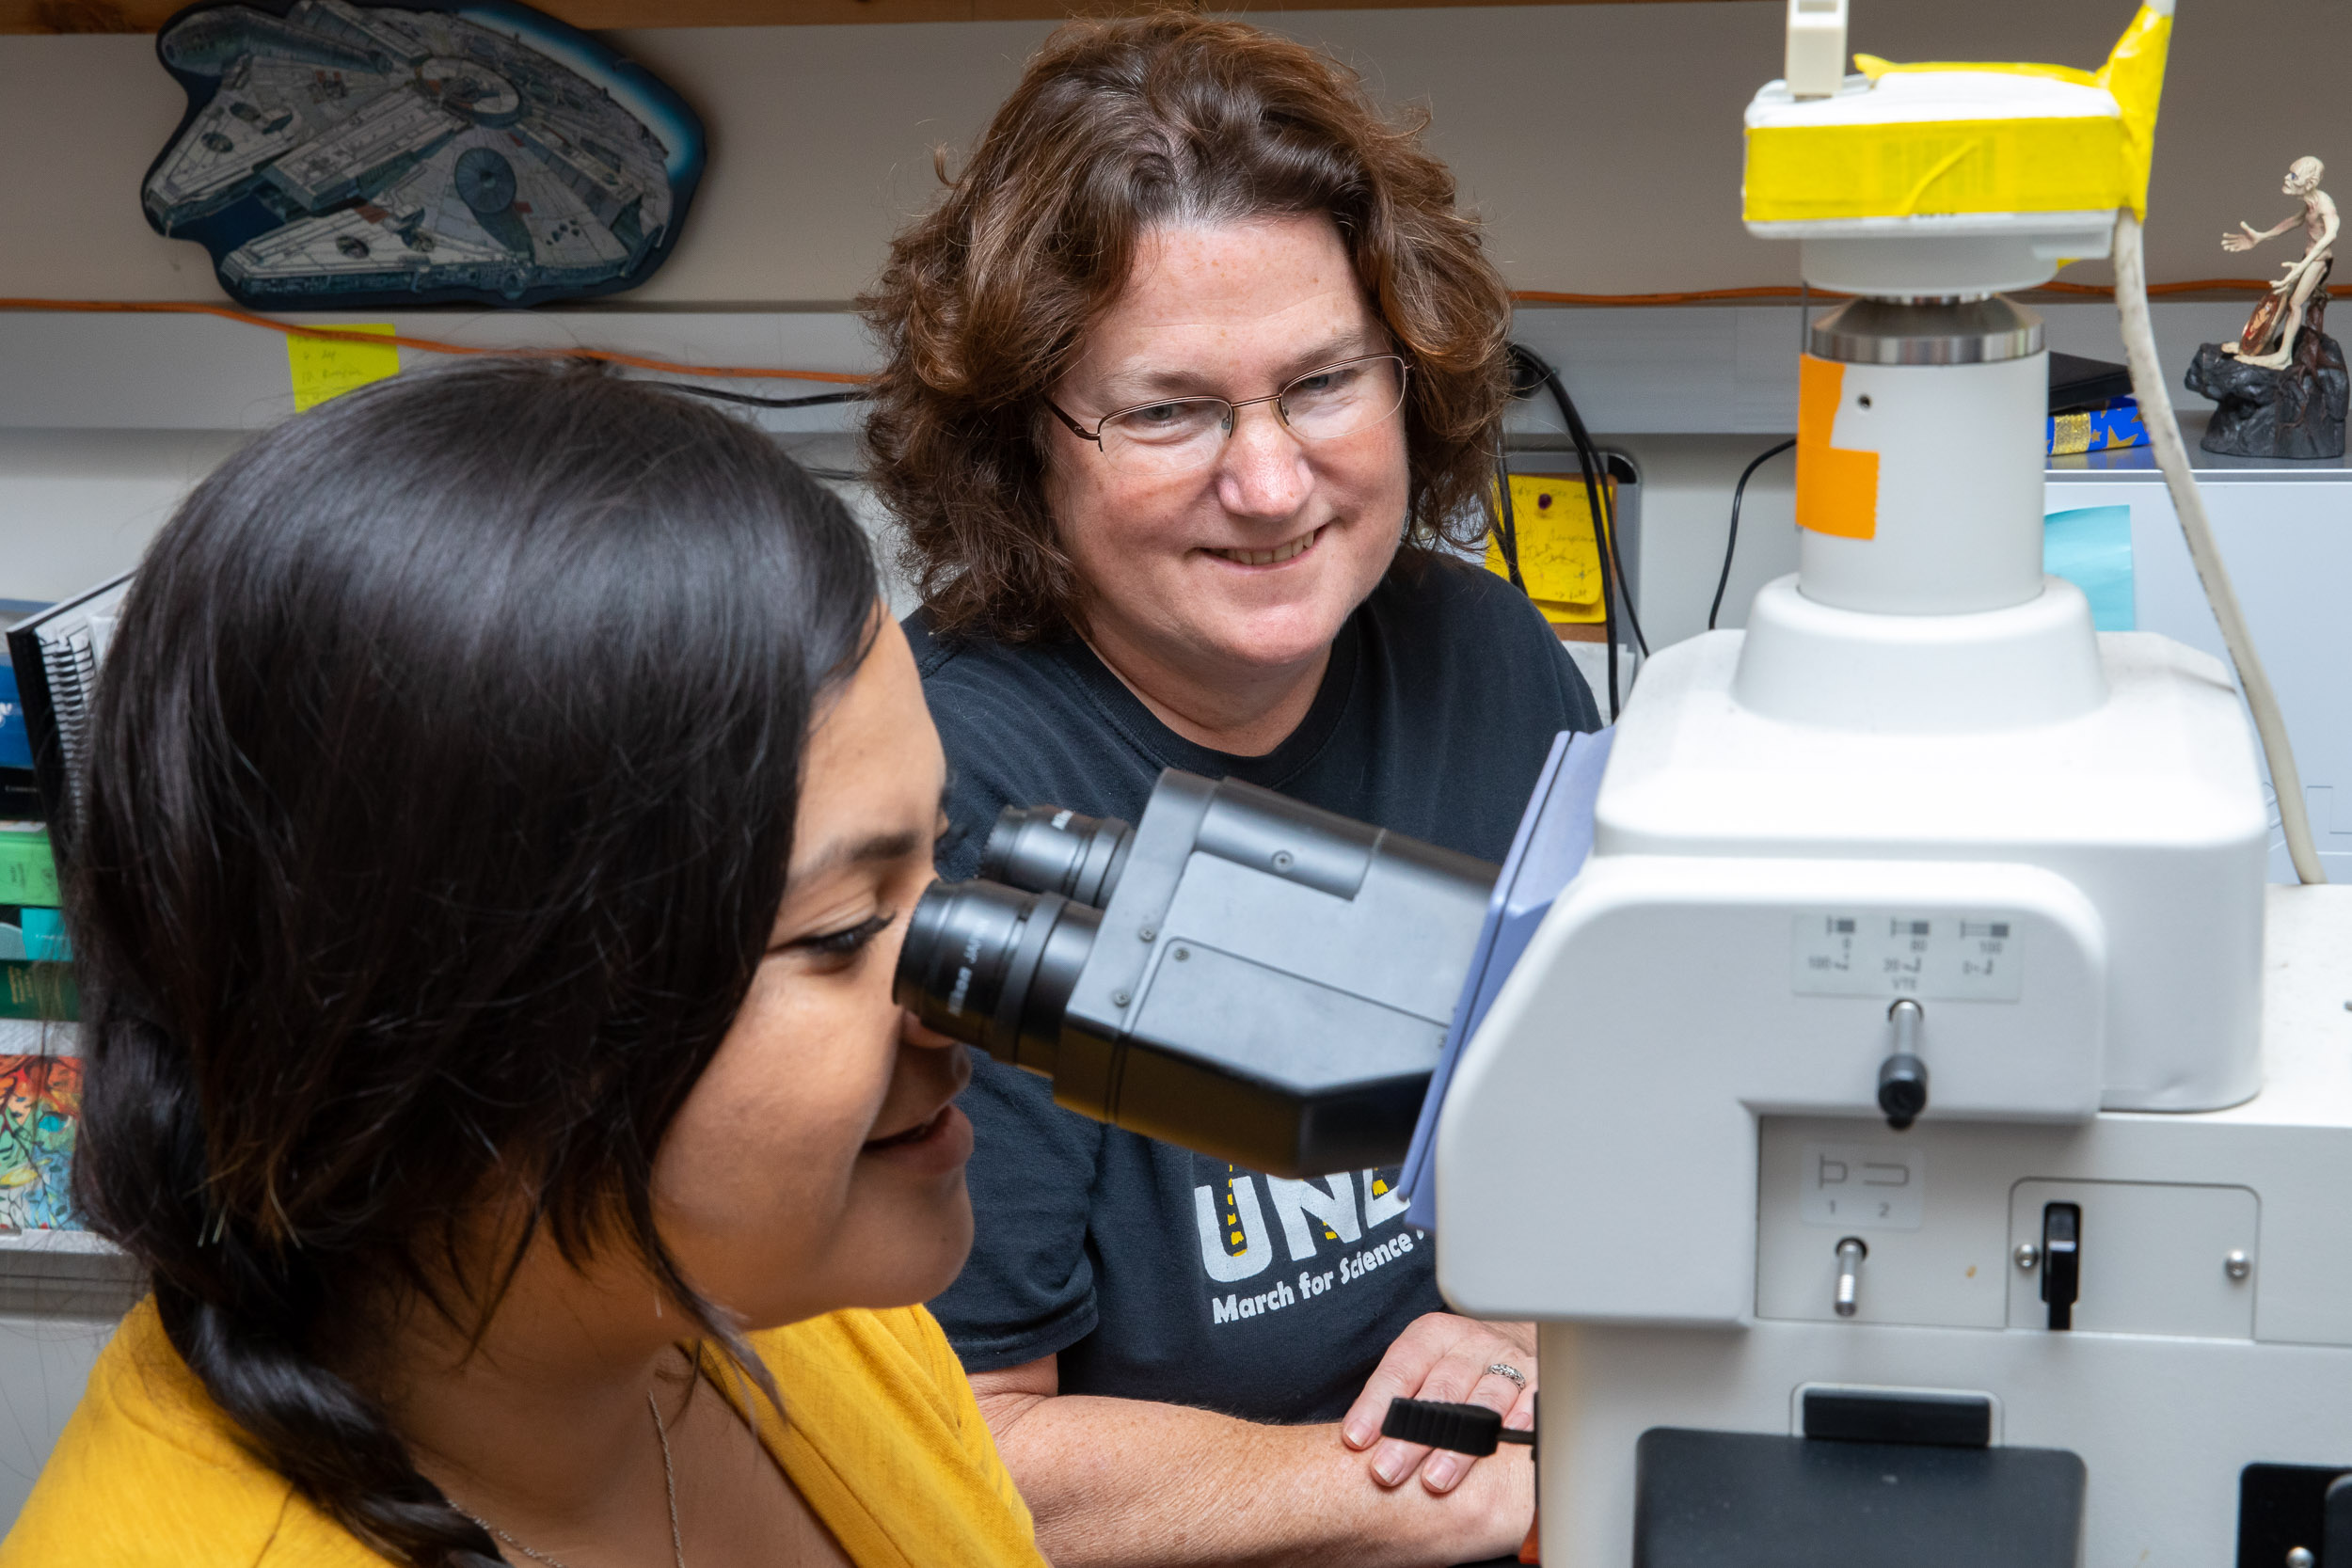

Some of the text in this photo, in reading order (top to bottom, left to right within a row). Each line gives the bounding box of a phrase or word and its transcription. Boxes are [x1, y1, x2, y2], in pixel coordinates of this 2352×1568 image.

[1829, 1199, 1836, 1215] 1
[1878, 1202, 1890, 1218] 2
[1212, 1233, 1413, 1324] March for Science
